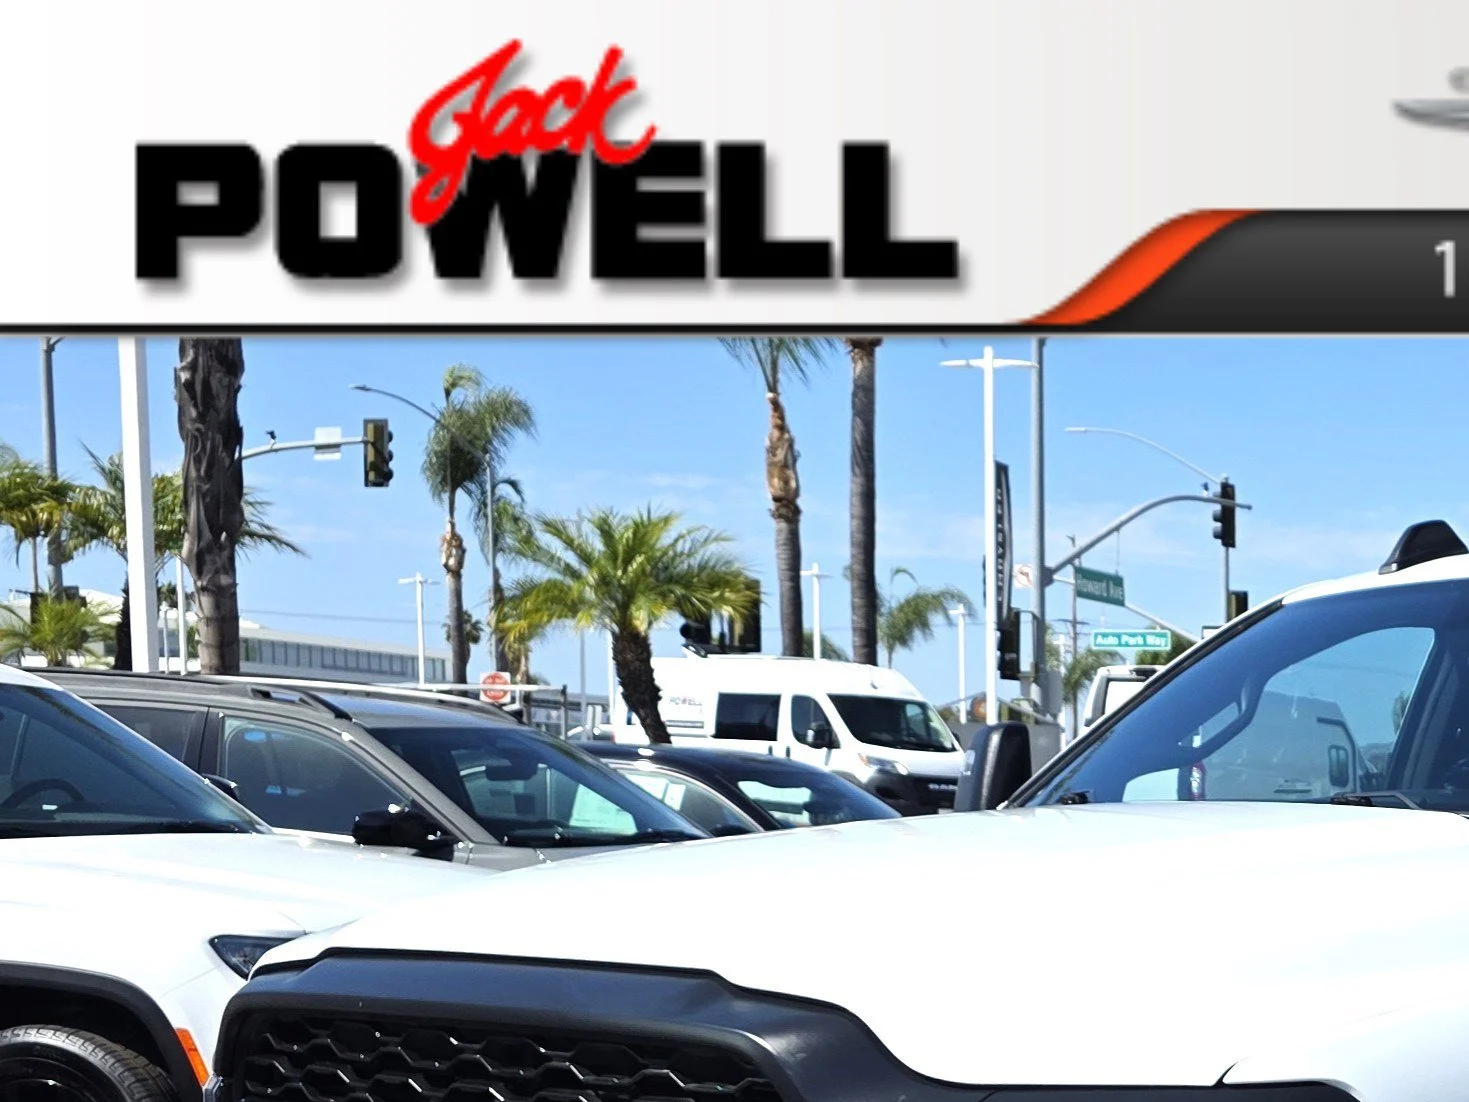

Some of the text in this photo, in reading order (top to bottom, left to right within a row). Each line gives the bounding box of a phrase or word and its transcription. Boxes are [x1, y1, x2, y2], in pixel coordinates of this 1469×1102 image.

[1095, 634, 1167, 647] Auto Park Way
